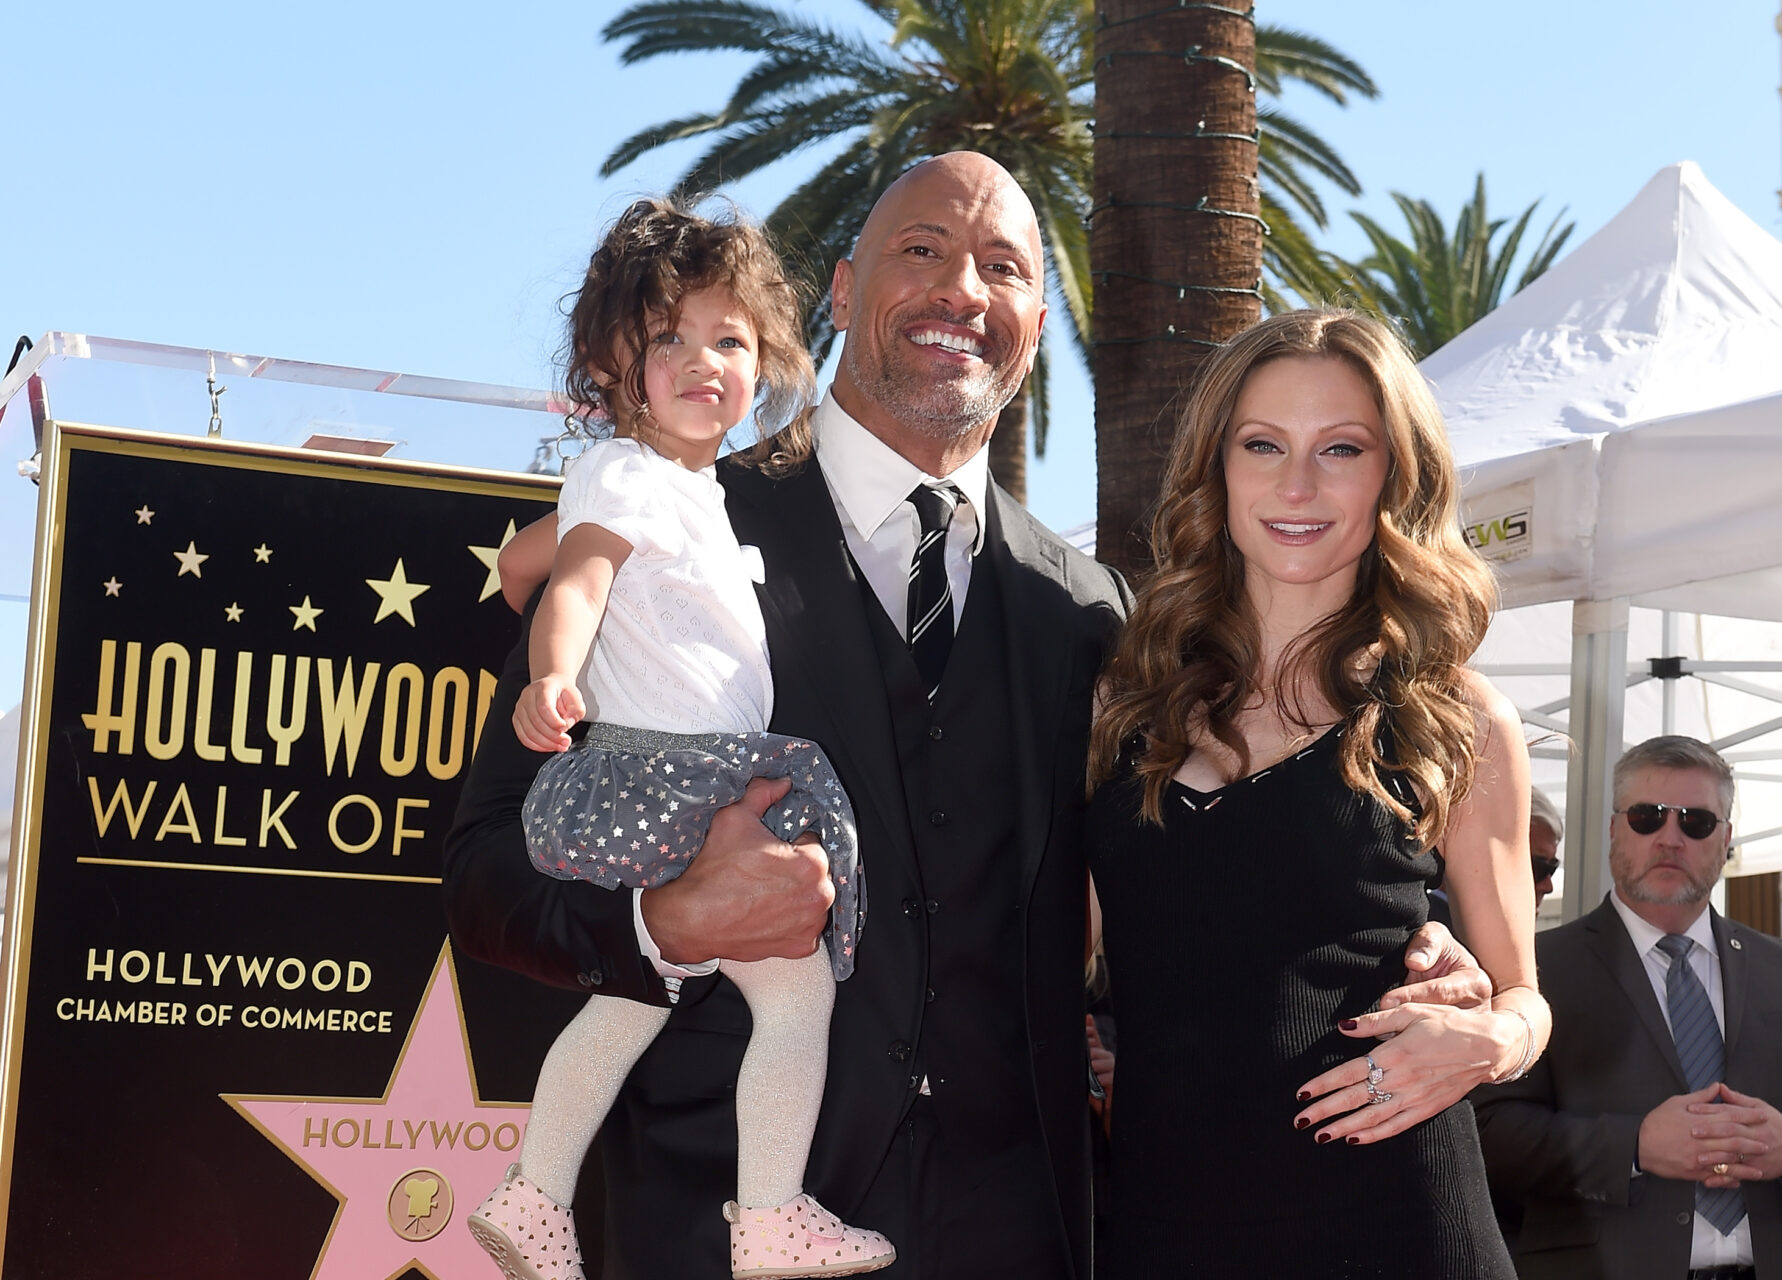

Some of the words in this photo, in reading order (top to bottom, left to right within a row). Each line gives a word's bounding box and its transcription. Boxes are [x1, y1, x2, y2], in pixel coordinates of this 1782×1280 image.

[87, 776, 300, 850] WALK
[328, 794, 430, 856] OF
[86, 948, 372, 993] HOLLYWOOD
[56, 998, 187, 1026] CHAMBER
[195, 1003, 233, 1027] OF
[241, 1005, 393, 1033] COMMERCE
[302, 1117, 527, 1152] HOLLYWOO
